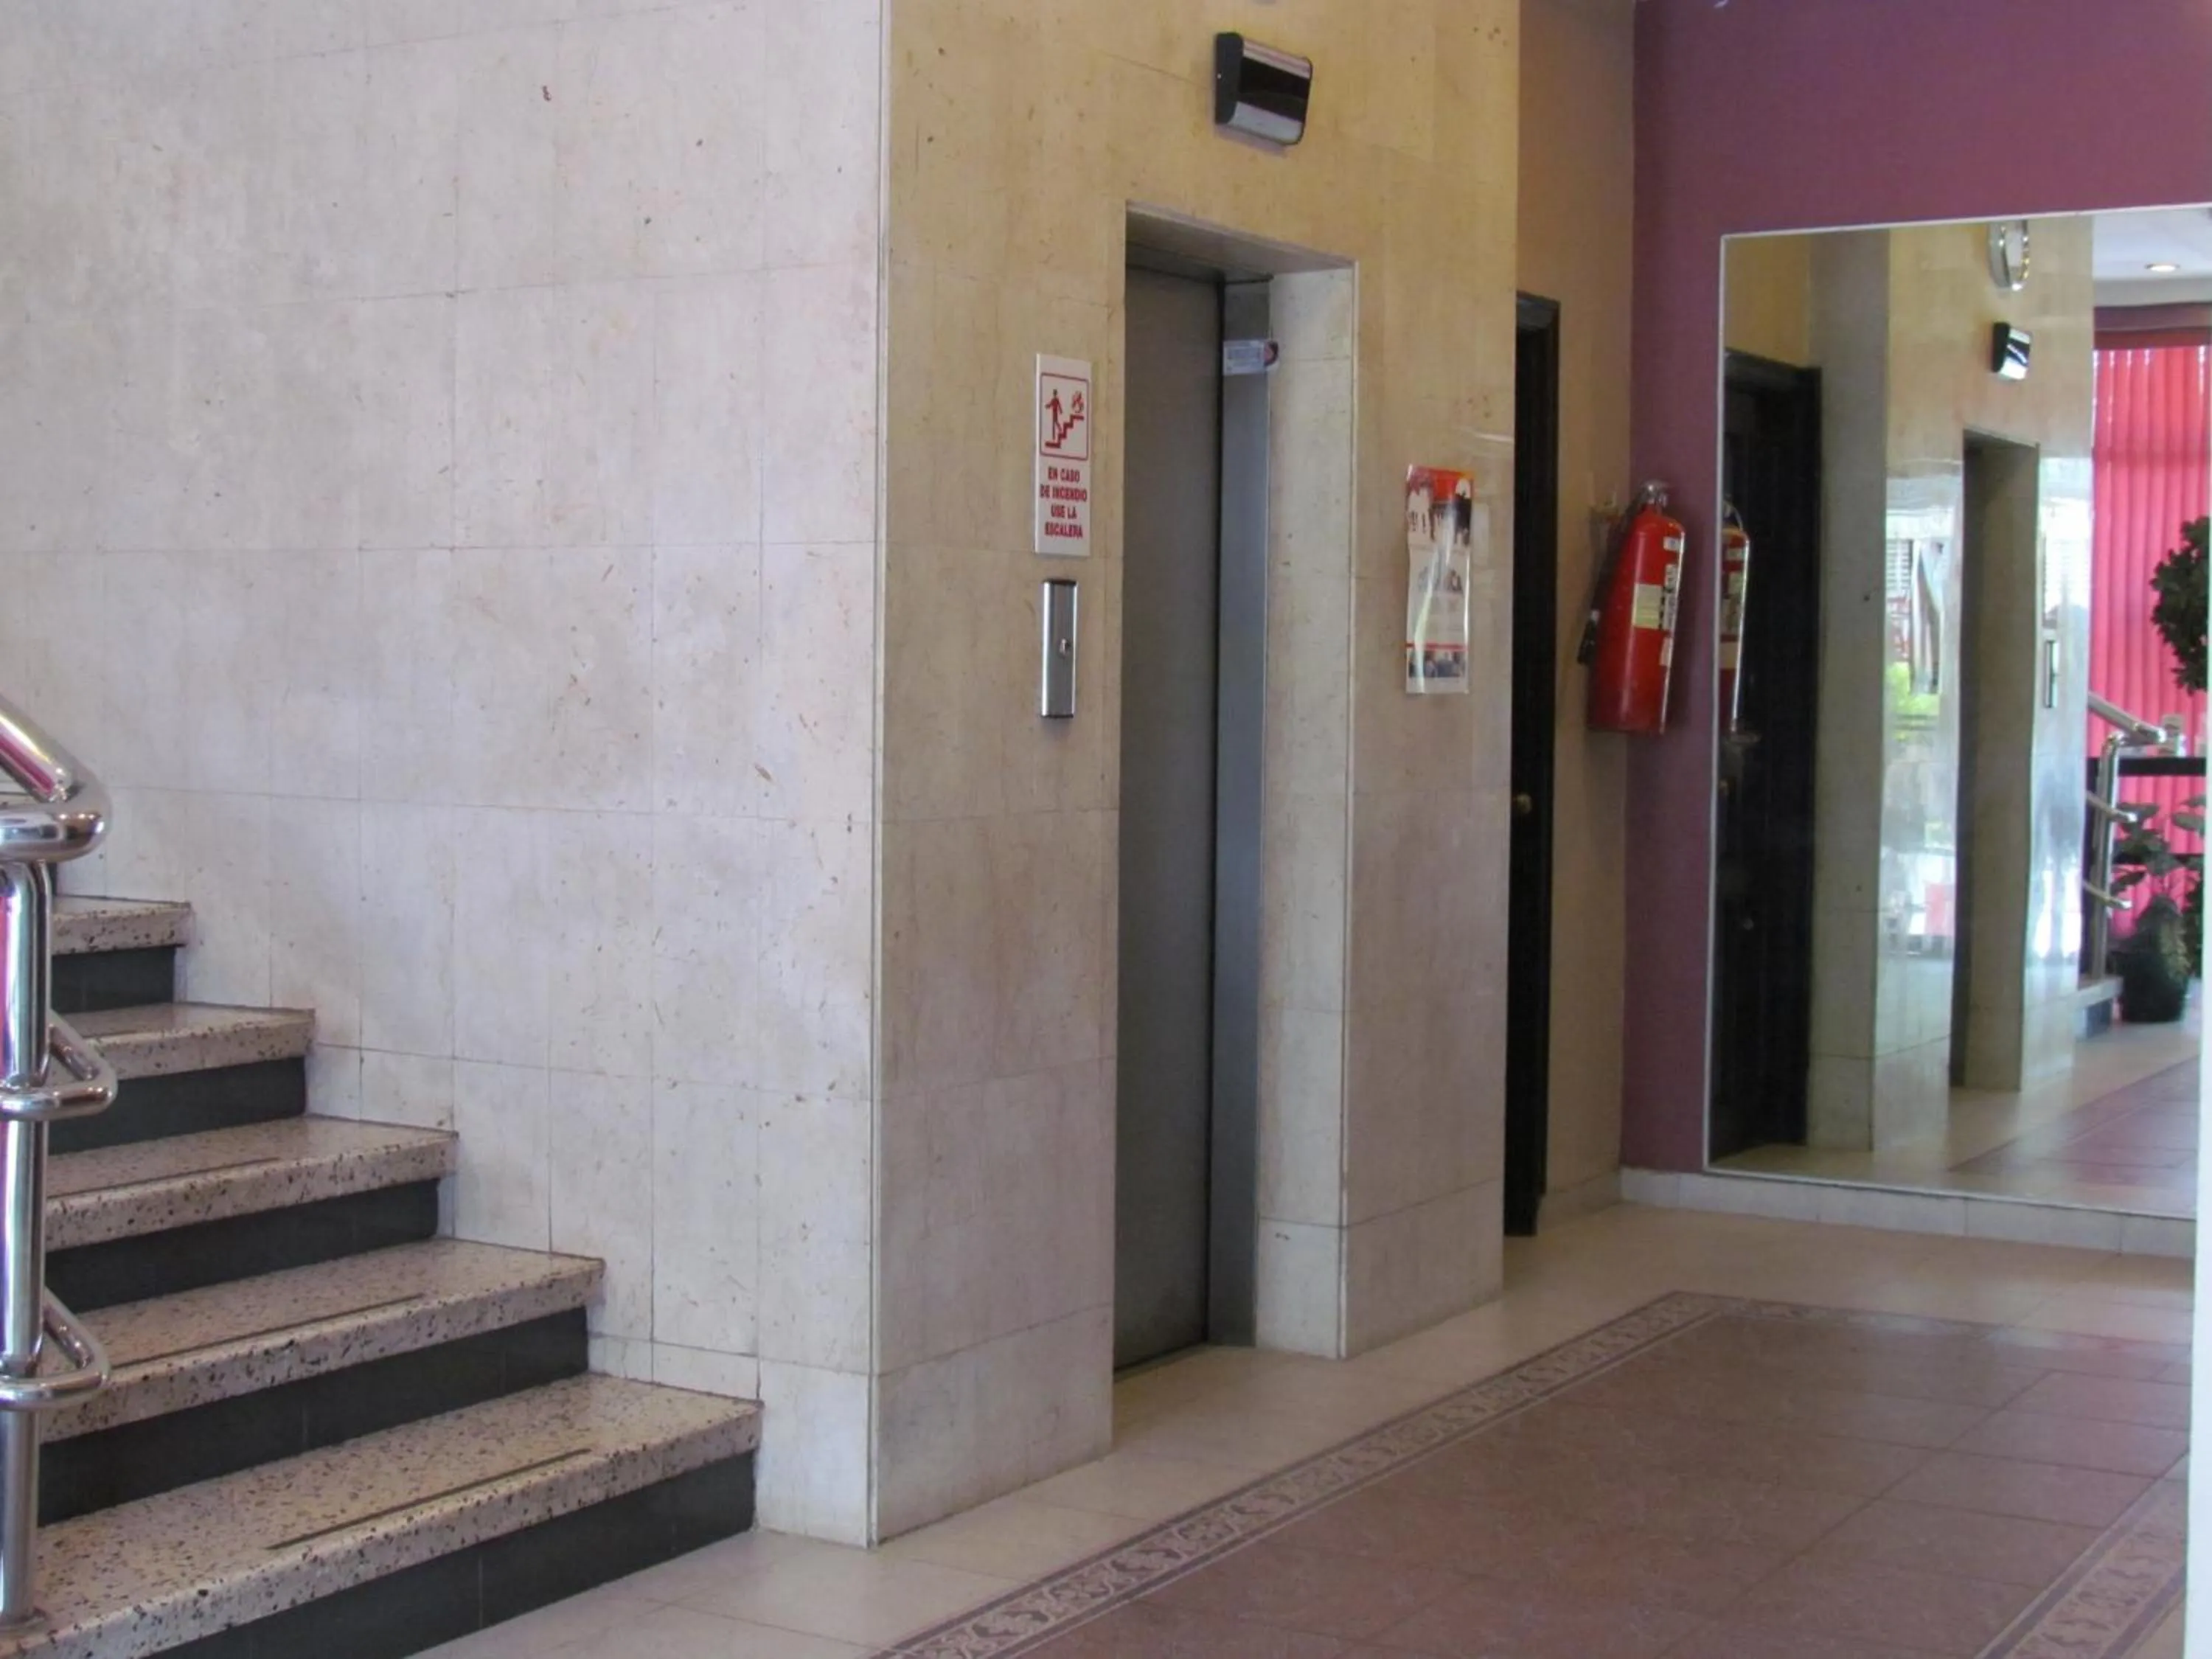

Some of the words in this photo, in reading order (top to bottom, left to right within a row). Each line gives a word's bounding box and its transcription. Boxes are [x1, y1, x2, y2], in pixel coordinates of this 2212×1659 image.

[1040, 484, 1050, 498] DE
[1068, 507, 1077, 519] LA
[1044, 521, 1083, 538] ESCALERA
